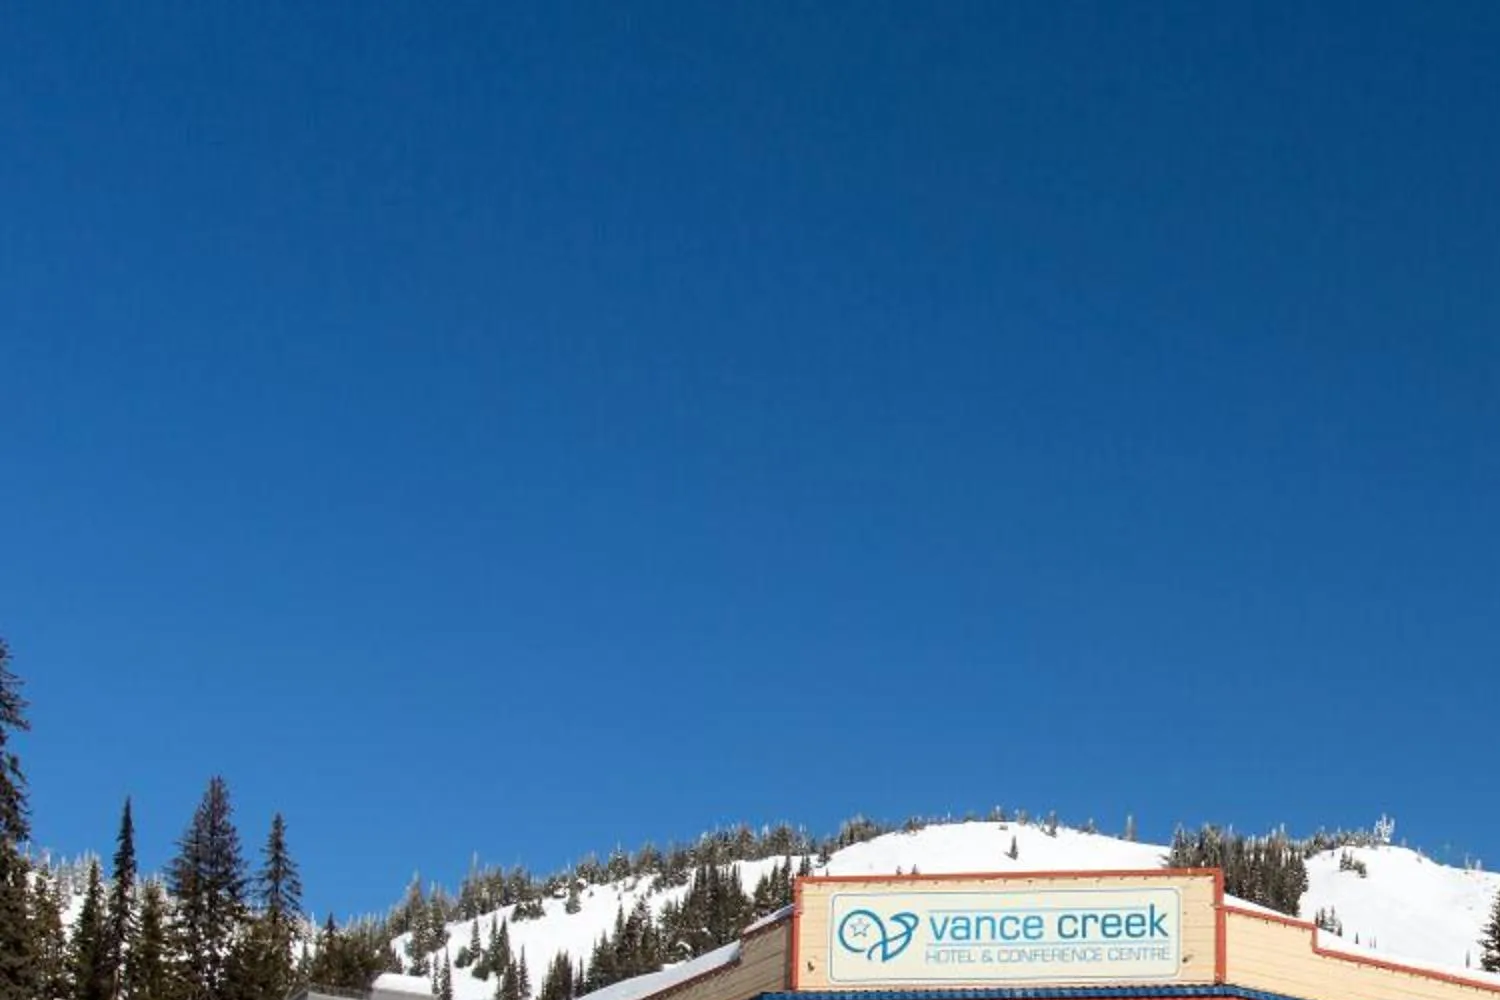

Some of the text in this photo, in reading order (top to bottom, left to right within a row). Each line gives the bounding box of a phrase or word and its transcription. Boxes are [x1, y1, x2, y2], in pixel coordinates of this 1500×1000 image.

[929, 904, 1169, 941] vance creek
[925, 946, 1171, 963] HOTEL & CONFERENCE CENTRE
